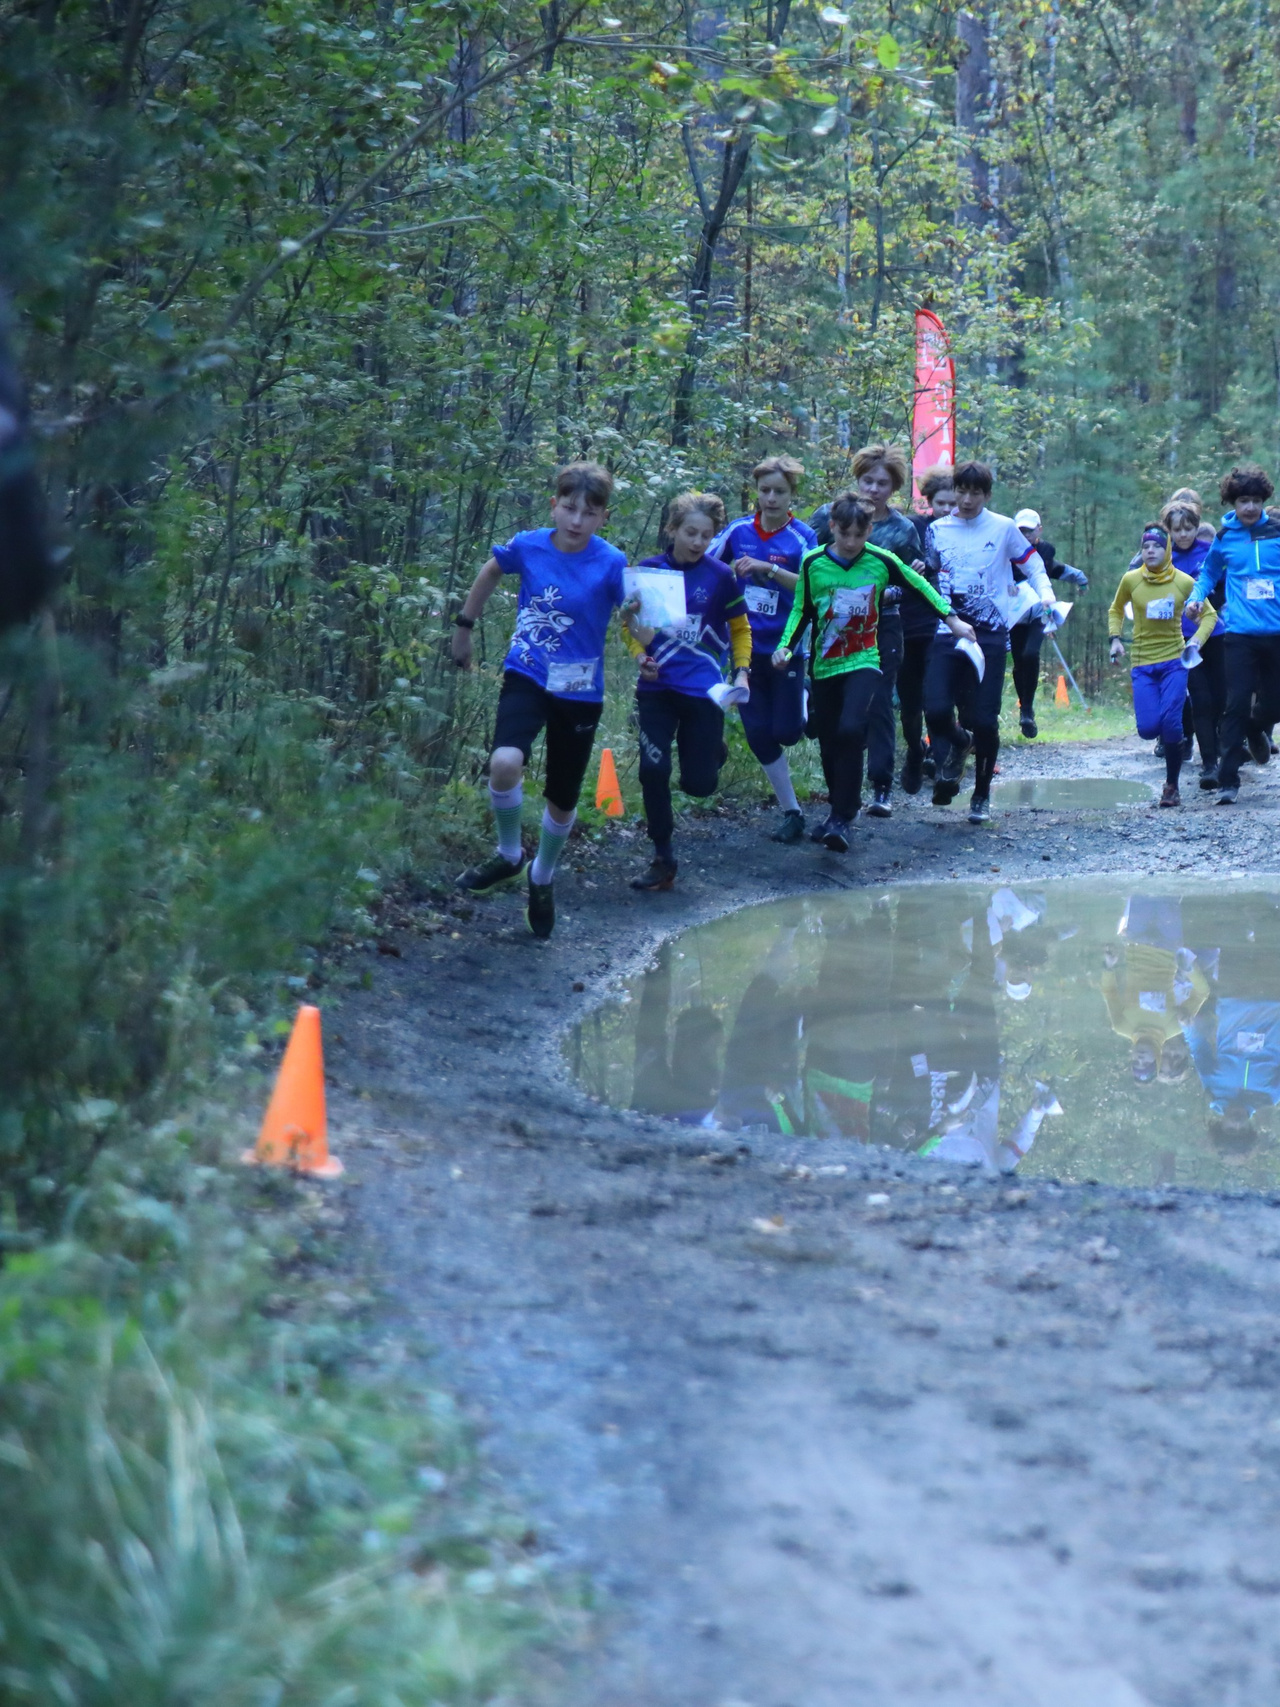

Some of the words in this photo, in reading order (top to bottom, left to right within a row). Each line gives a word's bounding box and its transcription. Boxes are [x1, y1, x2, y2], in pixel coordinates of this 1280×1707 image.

[967, 584, 985, 596] 325
[757, 602, 774, 614] 301
[848, 605, 867, 615] 304
